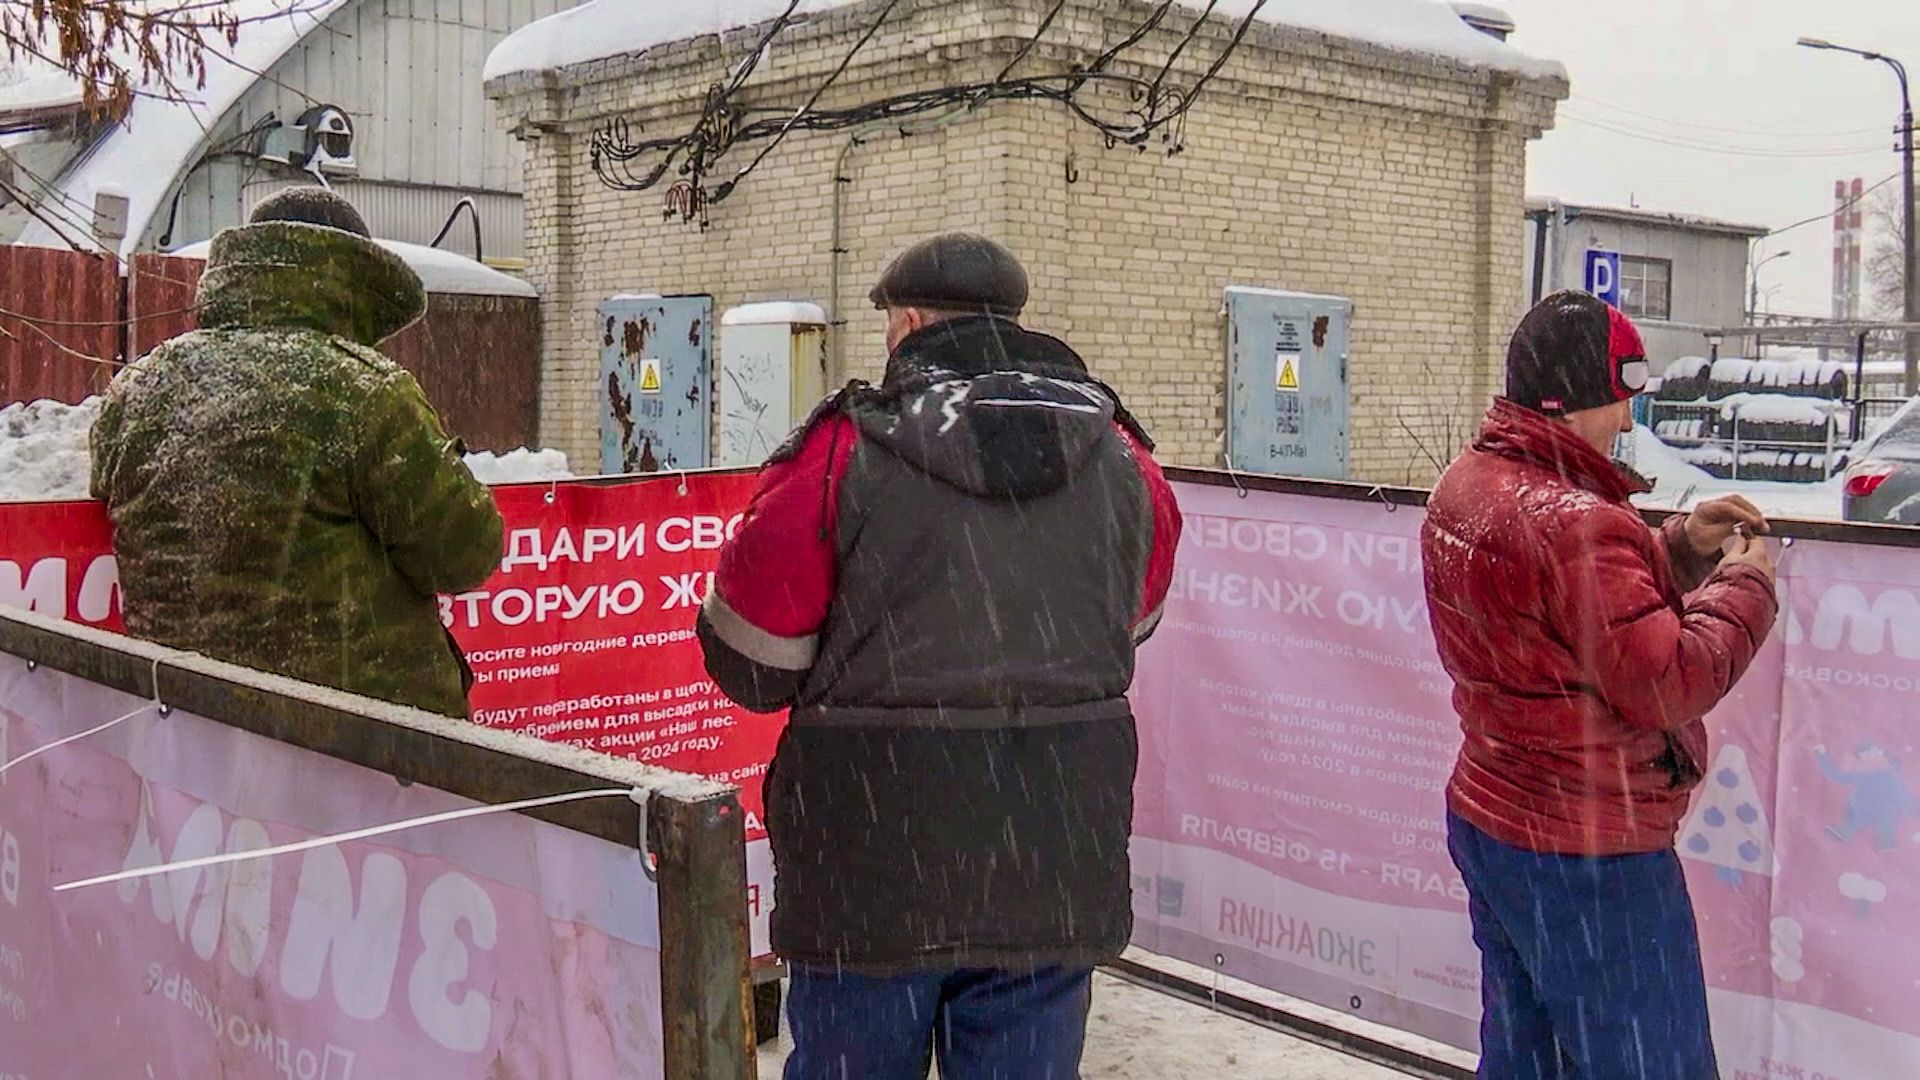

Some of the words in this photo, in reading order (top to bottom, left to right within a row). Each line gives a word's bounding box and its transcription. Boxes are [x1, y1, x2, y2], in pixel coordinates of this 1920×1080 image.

[1593, 257, 1612, 298] P
[501, 522, 645, 573] ДАРИ
[473, 706, 528, 725] будут
[662, 688, 672, 699] в
[603, 711, 640, 730] для
[600, 731, 656, 749] акции
[702, 714, 738, 729] лес.
[641, 741, 679, 761] 2024
[682, 735, 724, 752] году.
[731, 763, 769, 781] сайт
